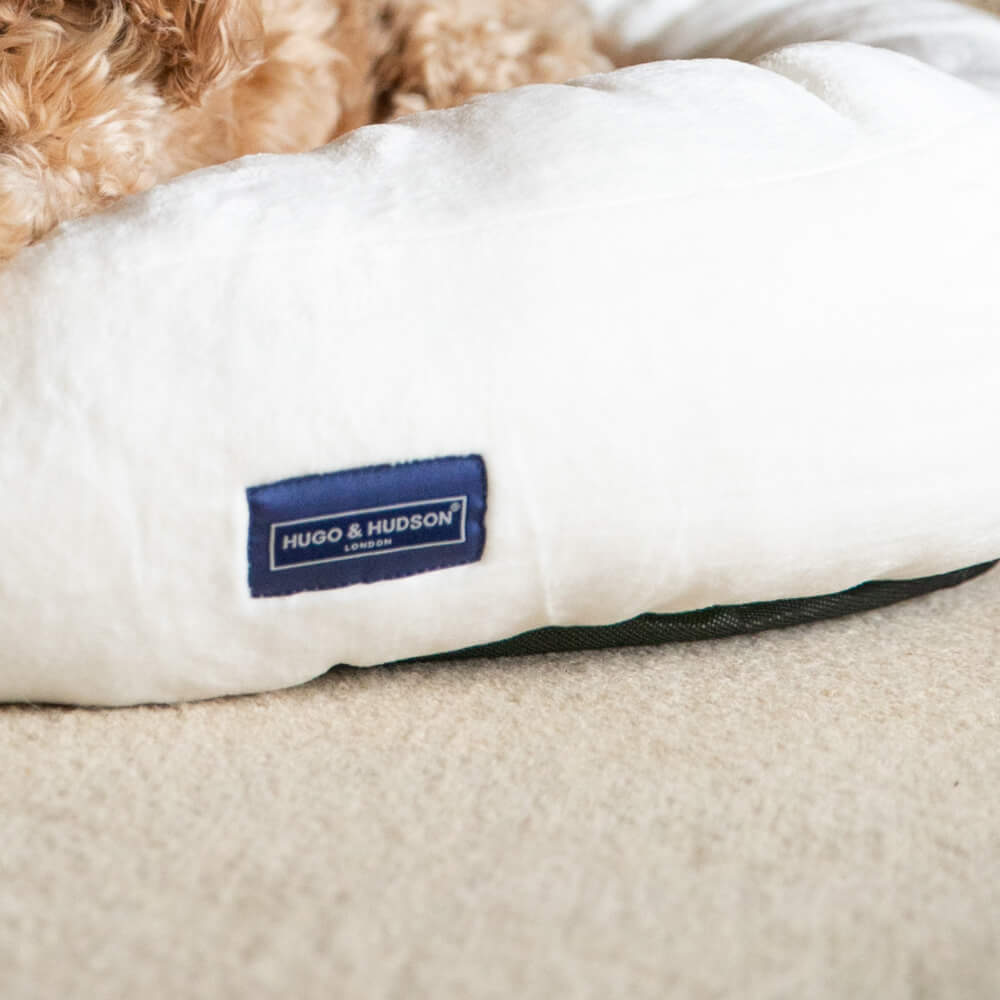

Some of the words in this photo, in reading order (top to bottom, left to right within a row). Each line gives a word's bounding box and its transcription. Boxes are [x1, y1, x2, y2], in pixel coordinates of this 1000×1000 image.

[282, 527, 343, 550] HUGO
[347, 522, 363, 539] &
[344, 538, 392, 552] LONDON
